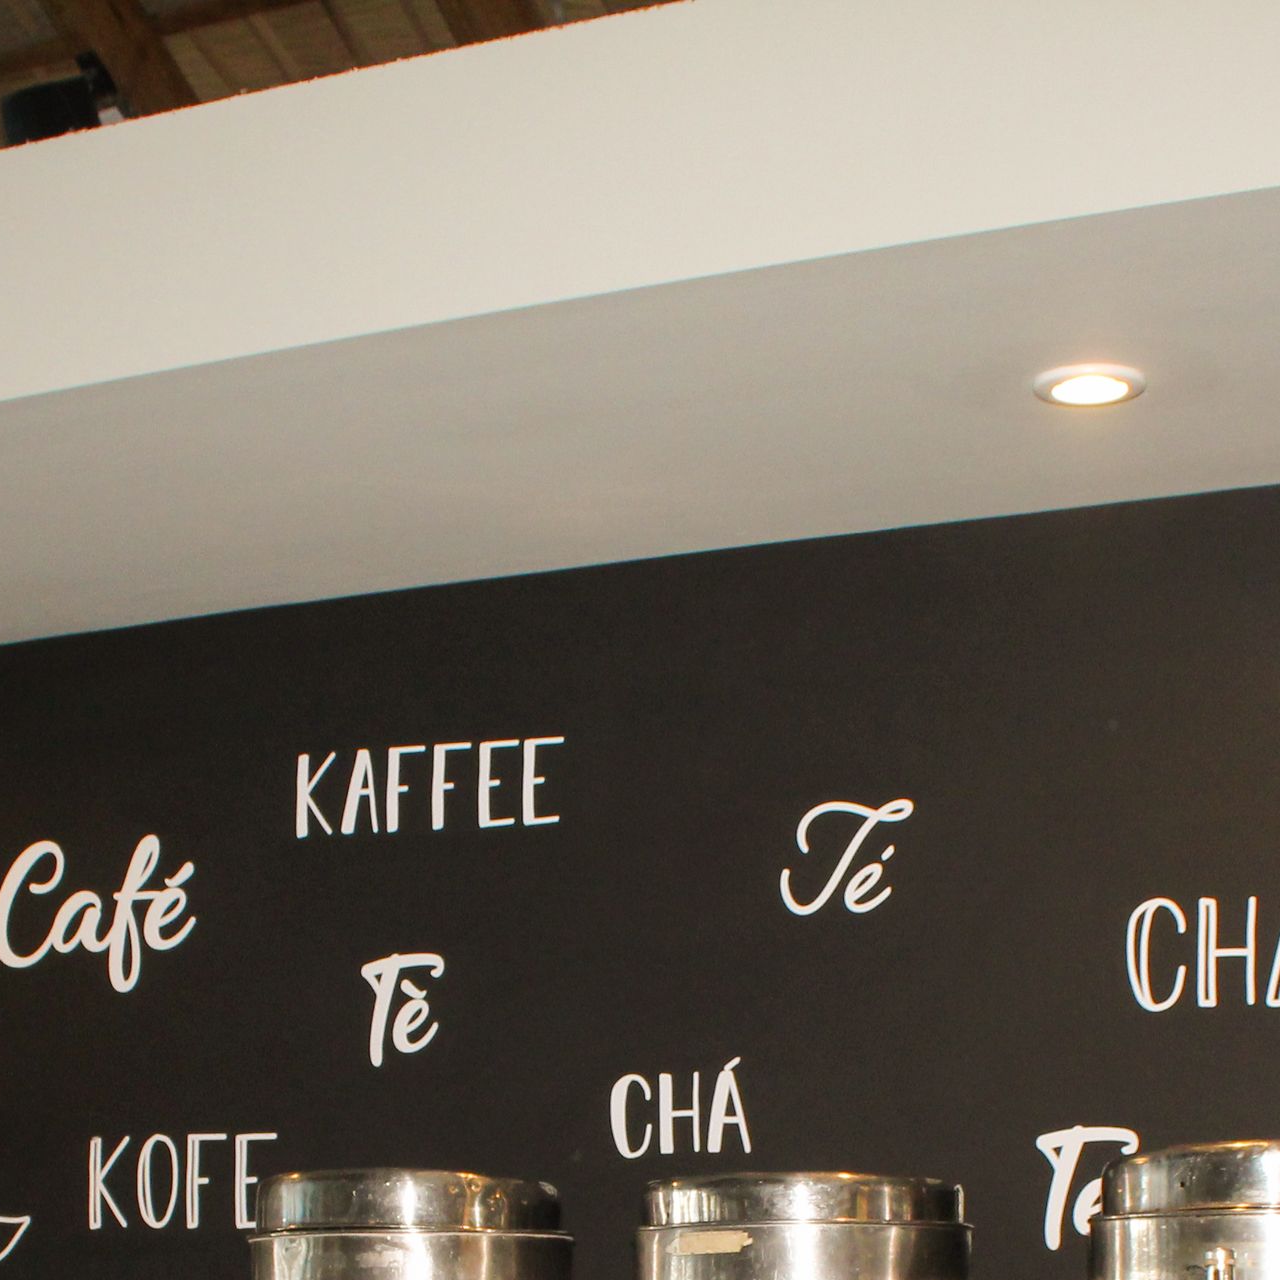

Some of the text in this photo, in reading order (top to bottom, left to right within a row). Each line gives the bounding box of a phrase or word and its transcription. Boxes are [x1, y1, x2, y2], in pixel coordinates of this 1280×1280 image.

[295, 736, 565, 839] KAFFEE
[779, 798, 915, 916] Té
[360, 952, 445, 1068] Tè
[609, 1056, 752, 1159] CHÁ
[88, 1132, 279, 1230] KOFE
